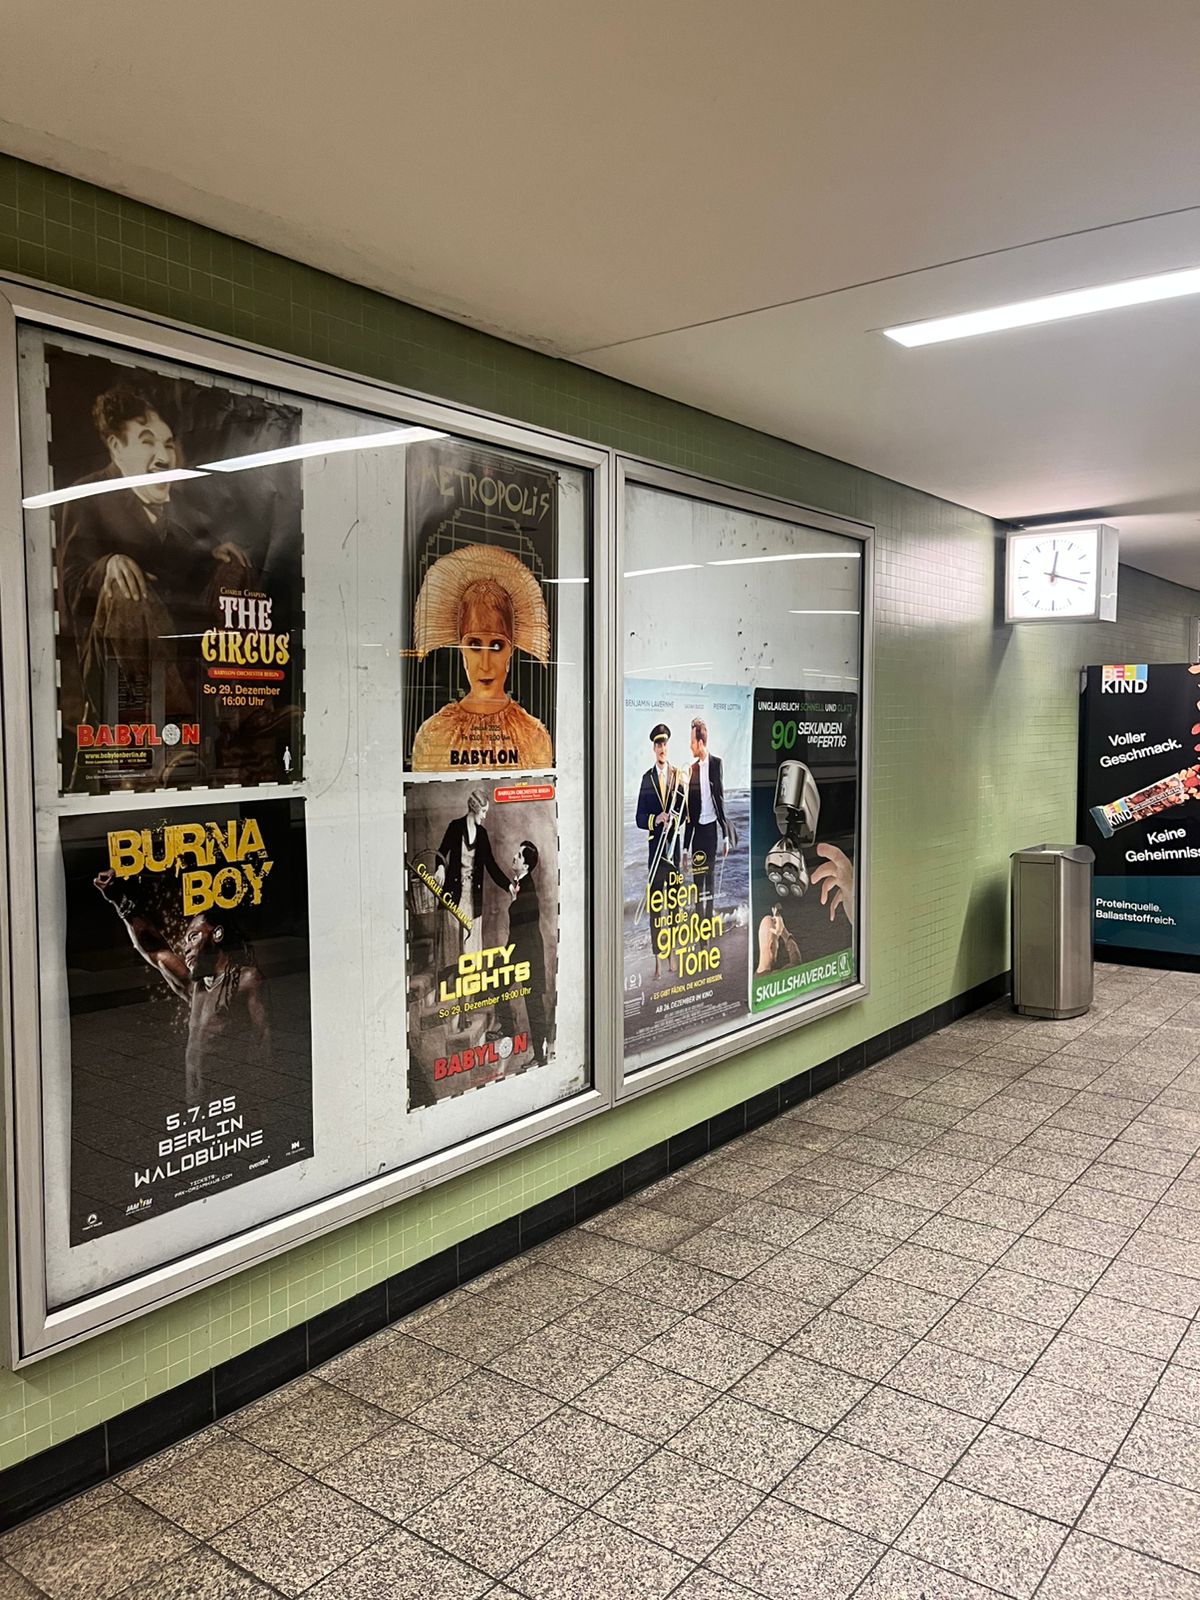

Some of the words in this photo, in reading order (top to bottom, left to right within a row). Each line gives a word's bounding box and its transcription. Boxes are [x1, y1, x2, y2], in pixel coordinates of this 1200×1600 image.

[219, 596, 272, 631] THE
[201, 627, 290, 665] CIRCUS
[203, 684, 217, 694] So
[219, 684, 233, 694] 29.
[235, 684, 281, 695] Dezember
[1101, 680, 1148, 694] KIND
[222, 696, 246, 706] 16:00
[248, 696, 265, 706] Uhr
[625, 699, 650, 708] BENJAMIN
[757, 701, 800, 711] UNGLAUBLICH
[800, 702, 824, 712] SCHNELL
[824, 703, 837, 712] UND
[76, 723, 200, 747] BABYLON
[771, 720, 798, 750] 90
[797, 721, 843, 735] SEKUNDEN
[806, 735, 818, 744] UND
[817, 735, 847, 748] FERTIG
[1108, 732, 1146, 747] Voller
[450, 749, 518, 765] BABYLON
[1100, 738, 1182, 768] Geschmack.
[1106, 809, 1133, 827] KIND
[107, 818, 268, 879] BURNA
[1146, 828, 1187, 845] Keine
[182, 861, 274, 916] BOY
[669, 870, 684, 886] Die
[646, 880, 698, 913] leisen
[1095, 897, 1162, 913] Proteinquelle.
[654, 911, 673, 928] und
[675, 908, 688, 924] die
[1095, 909, 1177, 926] Ballaststoffreich.
[657, 913, 723, 960] großen
[458, 943, 516, 975] CITY
[675, 945, 721, 978] Töne
[440, 961, 531, 1002] LIGHTS
[686, 982, 694, 991] DIE
[694, 978, 706, 988] NICHT
[756, 961, 838, 1002] SKULLSHAVER.DE
[438, 1008, 449, 1018] So
[451, 1005, 462, 1015] 29.
[464, 995, 500, 1012] Dezember
[501, 989, 518, 1001] 19:00
[519, 986, 532, 997] Uhr
[655, 1005, 663, 1014] AB
[670, 994, 696, 1009] DEZEMBER
[702, 990, 714, 999] KINO
[433, 1031, 528, 1082] BABYLON
[166, 1095, 236, 1131] 5.7.25
[158, 1114, 243, 1157] BERLIN
[134, 1129, 263, 1188] WALDBÜHNE
